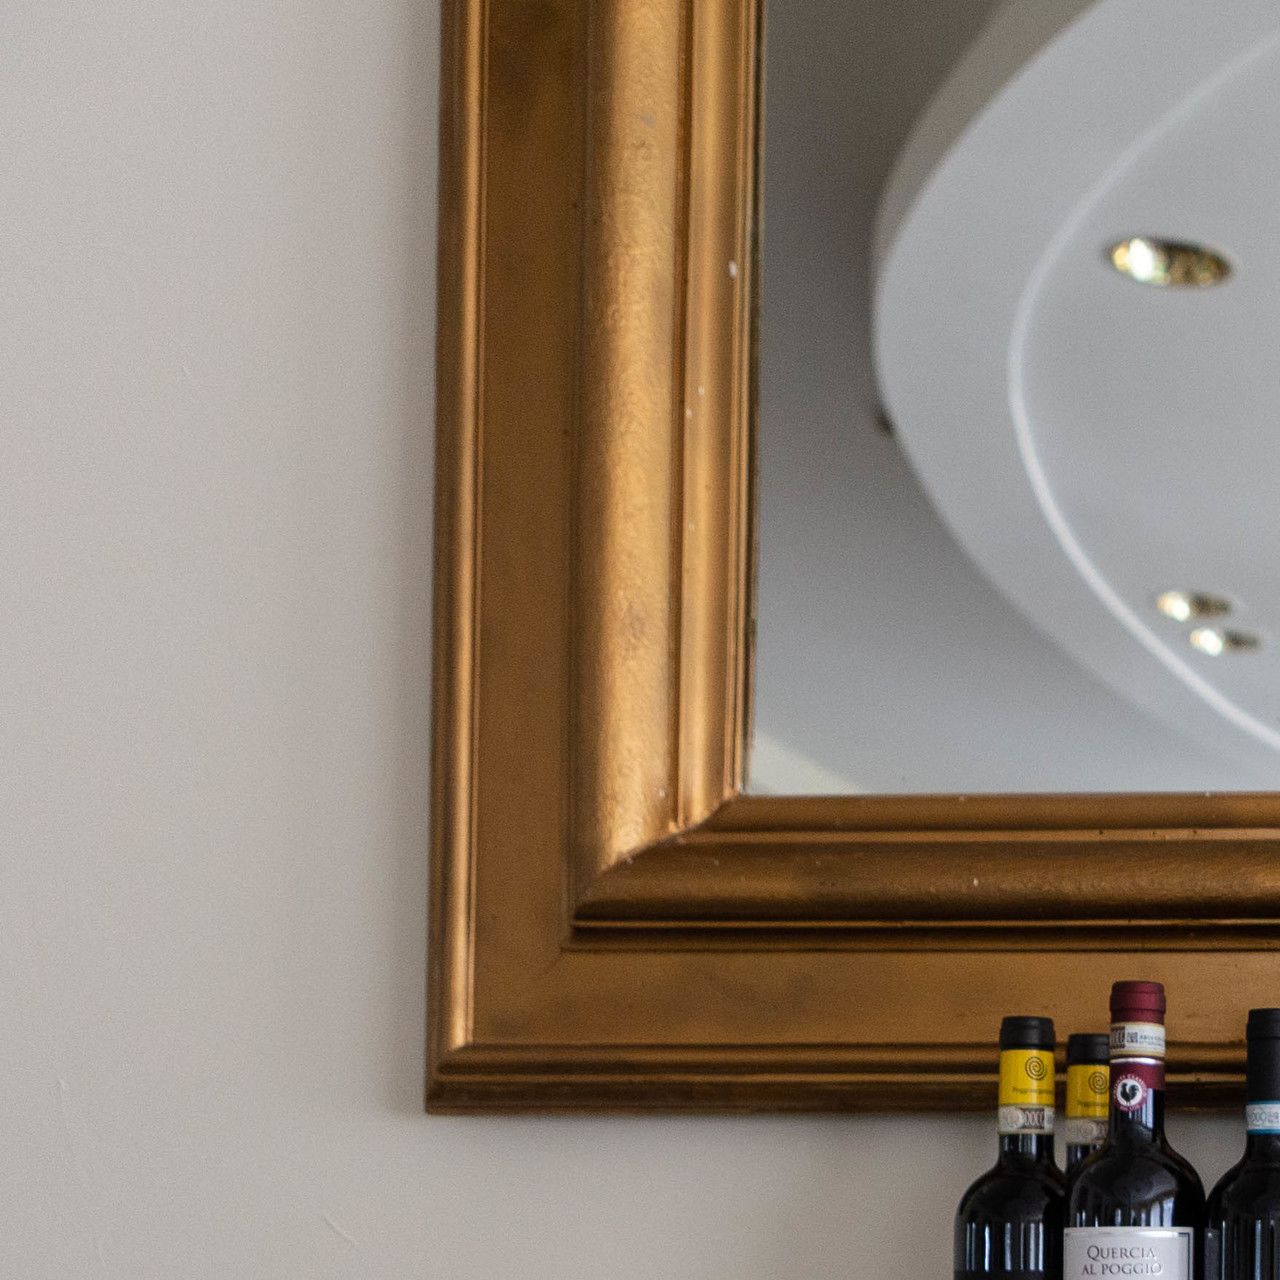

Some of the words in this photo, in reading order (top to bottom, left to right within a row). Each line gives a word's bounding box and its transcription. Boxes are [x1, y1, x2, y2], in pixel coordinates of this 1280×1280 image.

[1087, 1245, 1156, 1261] QUERCIA
[1082, 1263, 1097, 1275] AL
[1101, 1263, 1163, 1275] POGGIO
